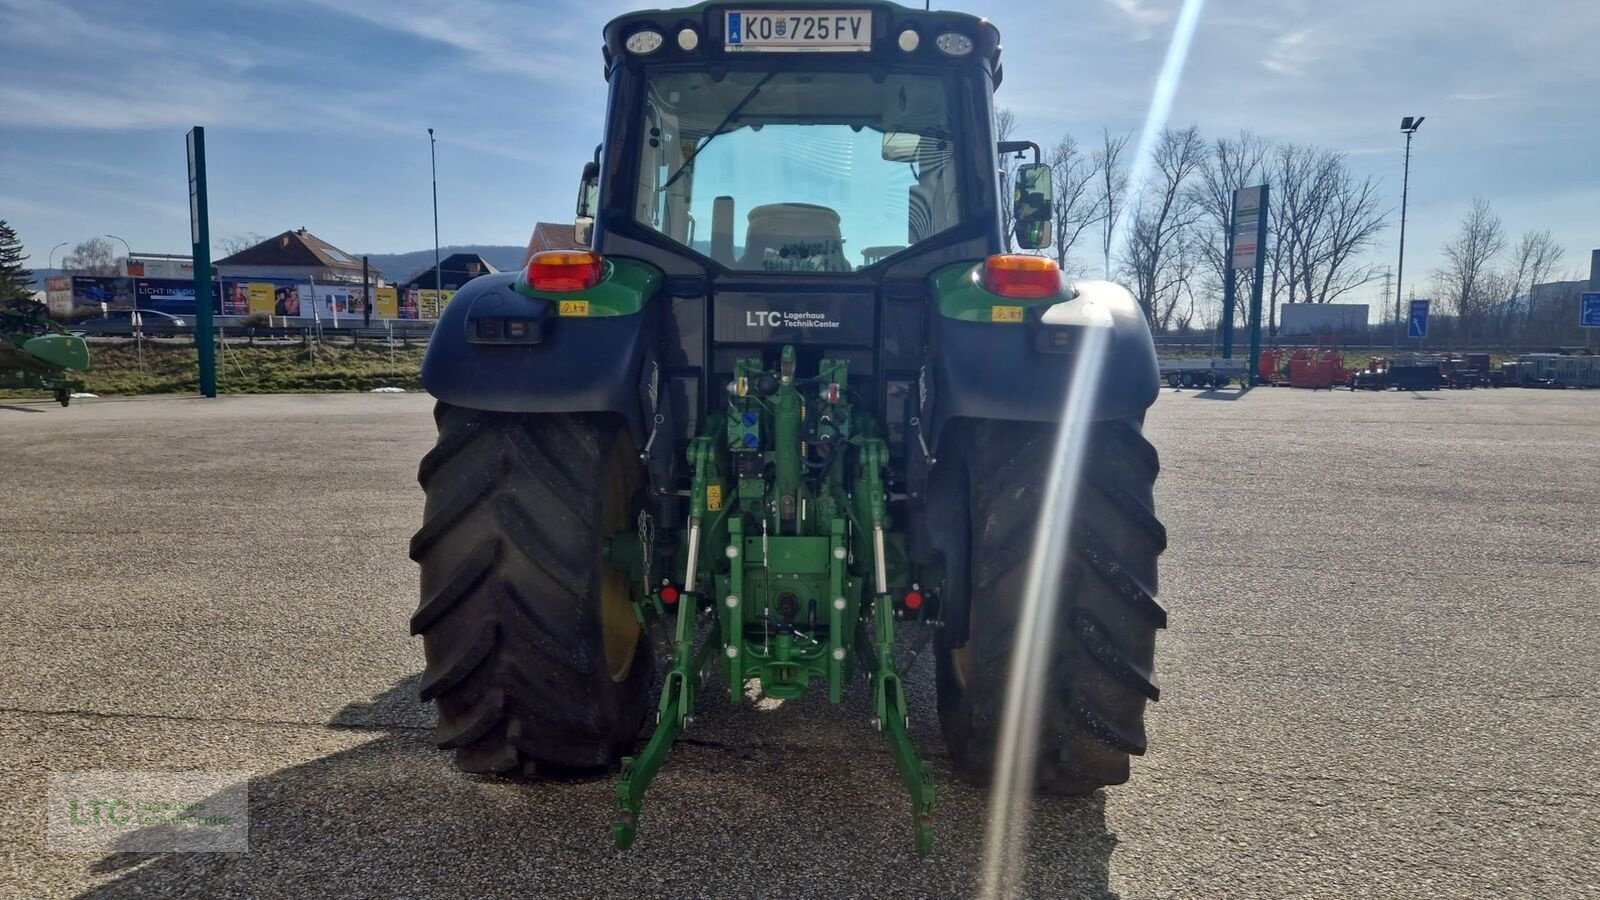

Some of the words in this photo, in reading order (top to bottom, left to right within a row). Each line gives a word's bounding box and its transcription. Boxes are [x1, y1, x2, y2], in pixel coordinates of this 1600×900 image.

[745, 17, 772, 40] KO
[789, 17, 829, 40] 725
[835, 17, 862, 40] FV
[139, 287, 164, 295] LICHT
[746, 310, 781, 327] LTC
[784, 311, 825, 321] Lagerhaus
[784, 320, 840, 328] TechnikCenter
